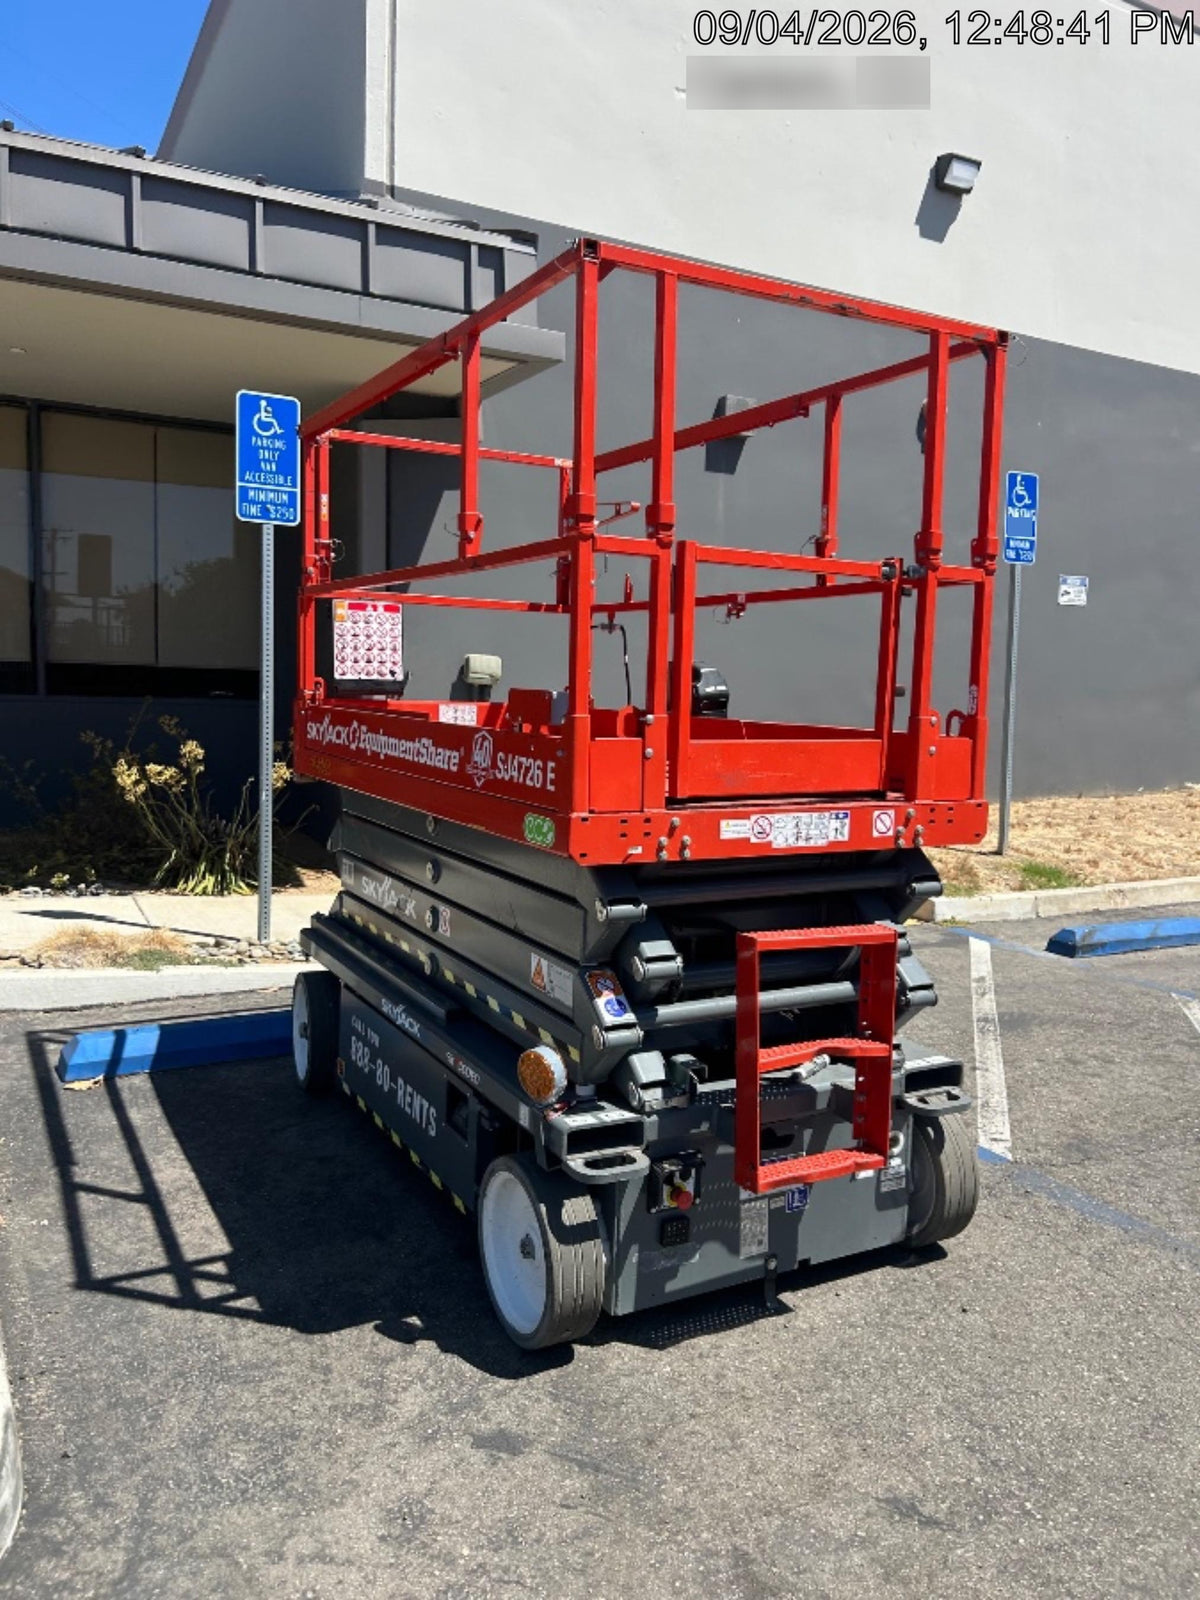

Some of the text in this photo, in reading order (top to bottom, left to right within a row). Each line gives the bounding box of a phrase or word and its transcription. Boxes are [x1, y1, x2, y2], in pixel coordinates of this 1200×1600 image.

[258, 449, 280, 462] ONLY
[244, 471, 293, 487] ACCESSIBLE
[248, 488, 289, 505] MINIMUM
[306, 713, 348, 746] SKYJACK
[359, 723, 461, 772] EquipmentShare
[495, 751, 556, 792] SJ4726 E
[351, 1035, 437, 1137] 888-80-RENTS
